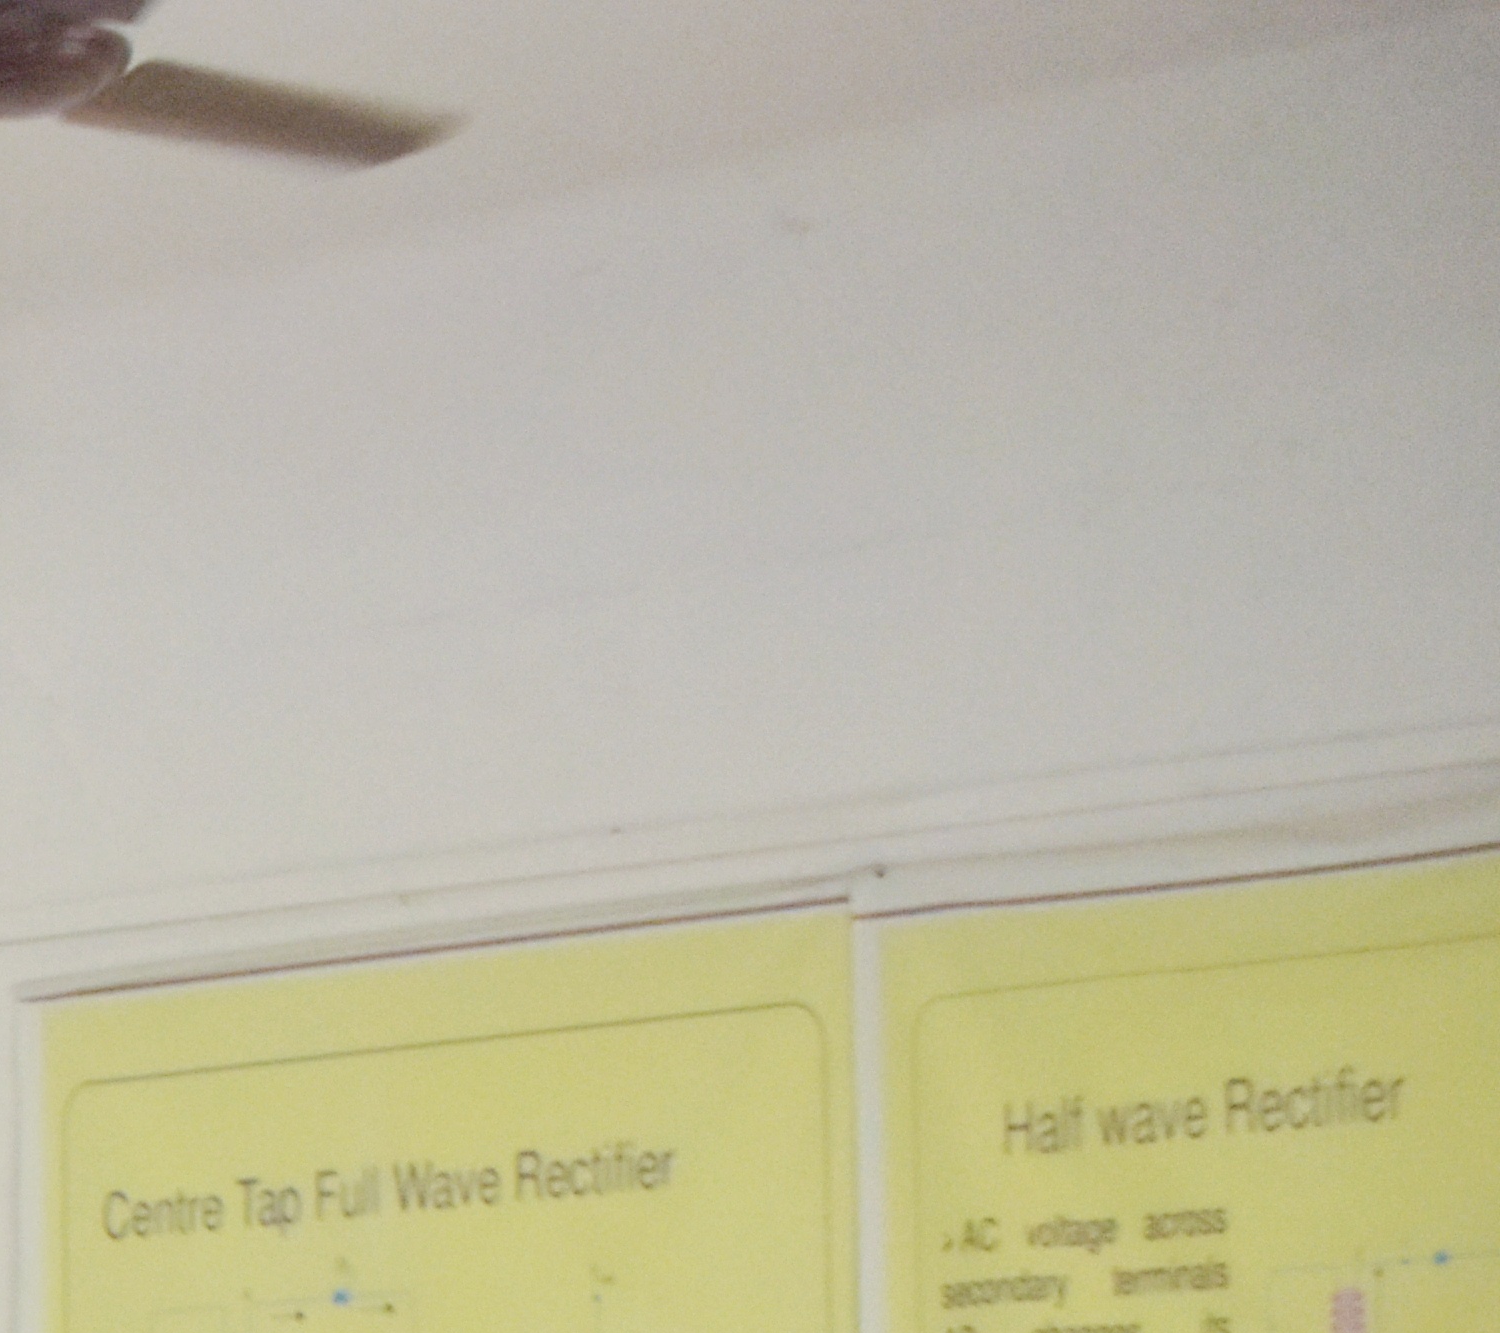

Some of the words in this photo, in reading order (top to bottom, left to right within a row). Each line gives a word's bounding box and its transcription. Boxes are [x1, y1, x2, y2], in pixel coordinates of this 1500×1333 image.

[1005, 1094, 1083, 1154] Half
[1099, 1096, 1208, 1145] wave
[1224, 1066, 1404, 1133] Rectifier
[103, 1188, 225, 1240] Centre
[236, 1176, 300, 1234] Tap
[315, 1166, 379, 1221] Full
[391, 1161, 500, 1213] Wave
[515, 1140, 675, 1200] Rectifier
[961, 1216, 997, 1252] AC
